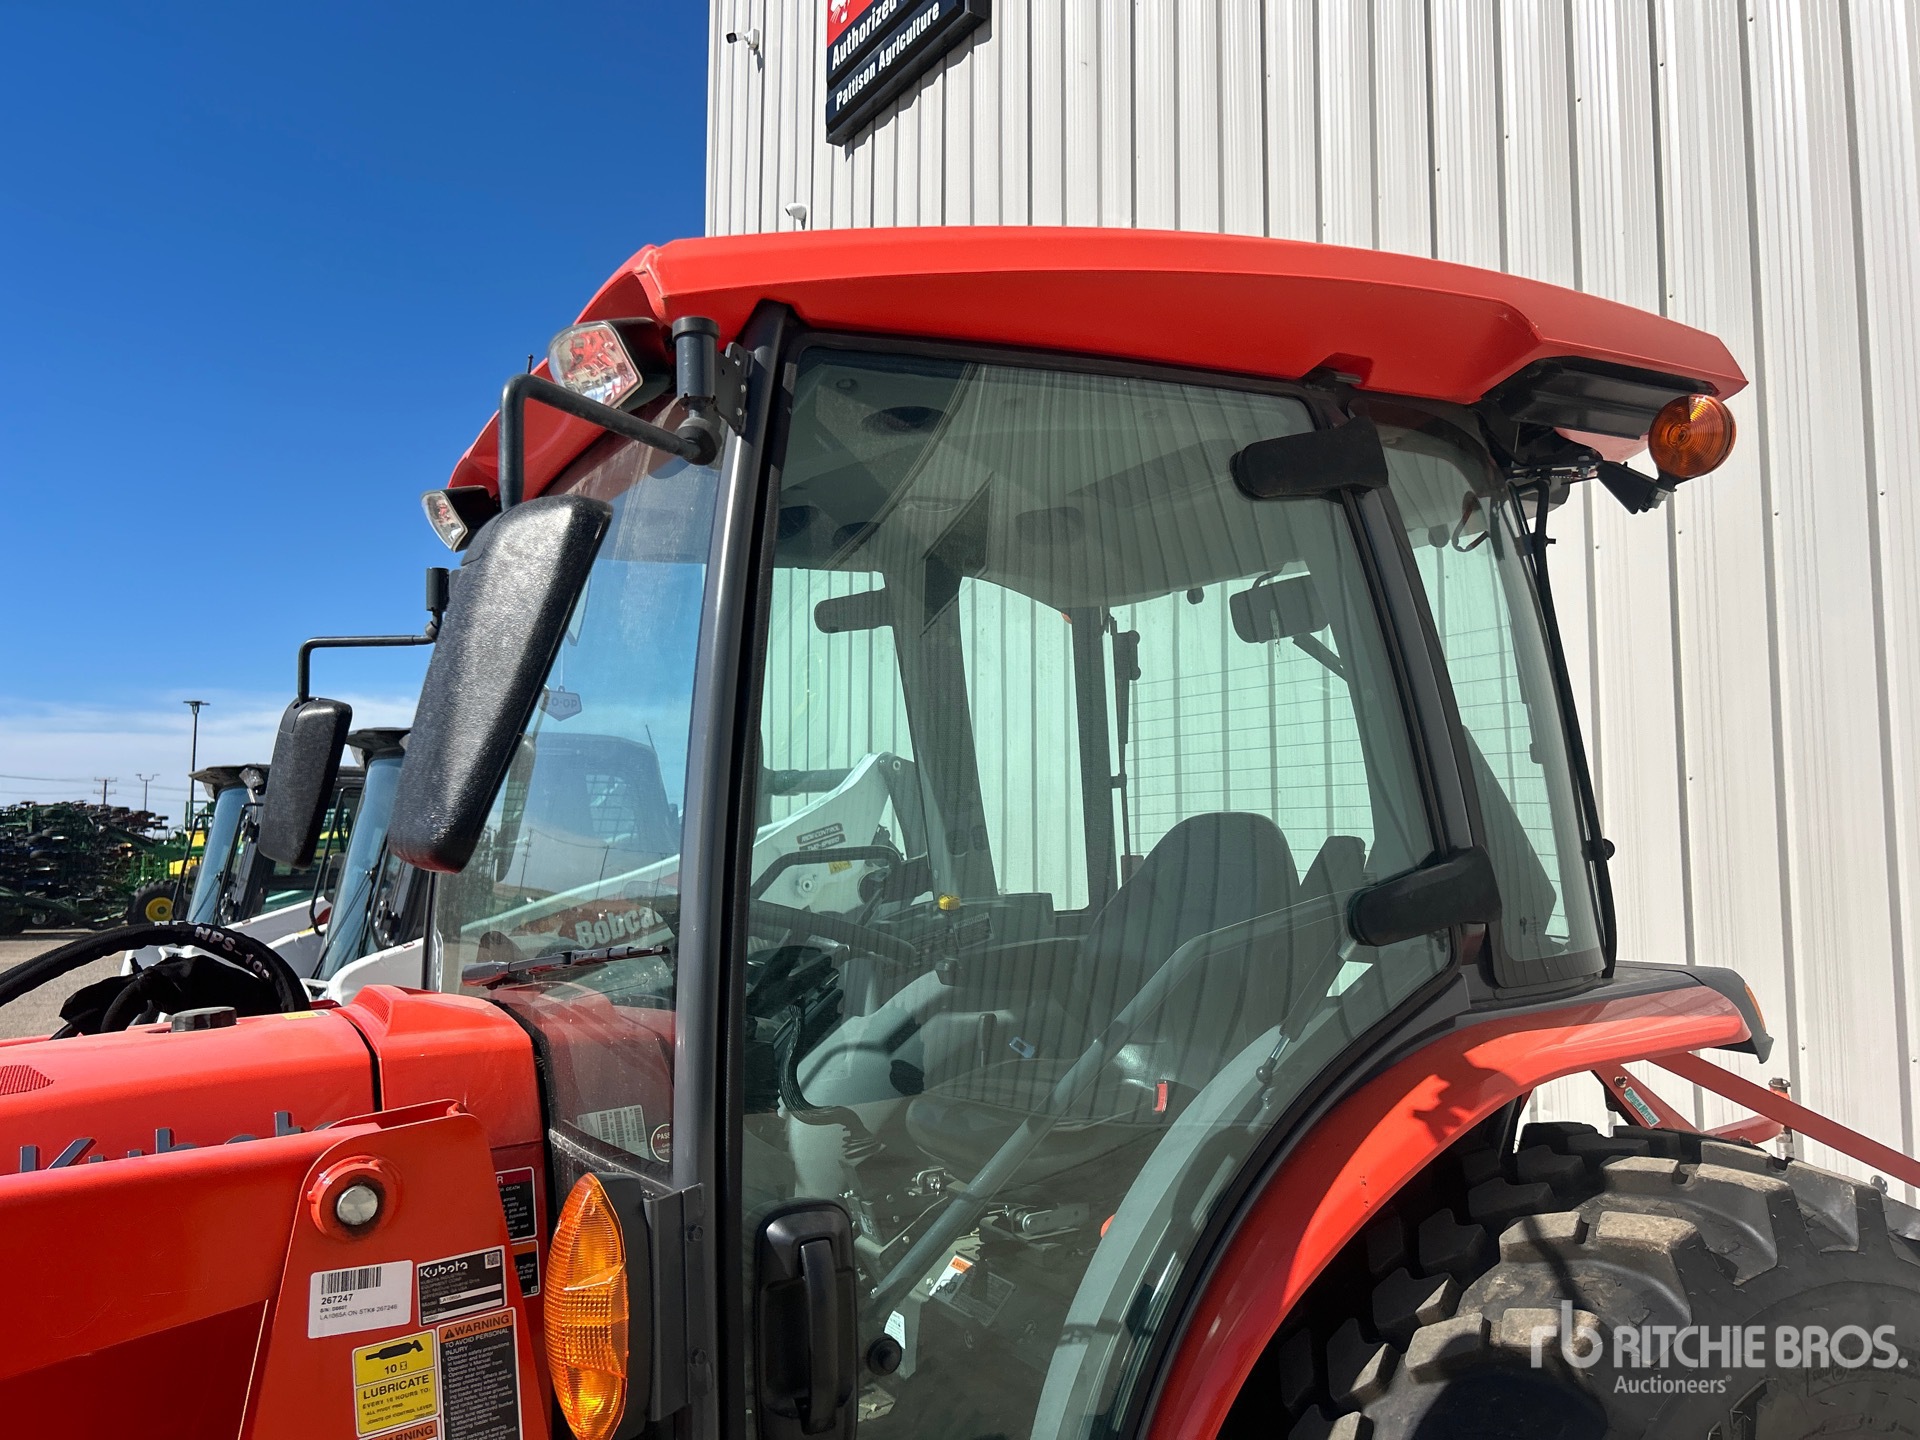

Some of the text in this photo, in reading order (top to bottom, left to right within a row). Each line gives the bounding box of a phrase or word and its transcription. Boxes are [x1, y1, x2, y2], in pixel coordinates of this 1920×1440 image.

[832, 0, 897, 70] Authorized
[836, 2, 940, 111] Pattison Agriculture
[420, 1261, 467, 1277] Kubota
[321, 1294, 353, 1305] 267247
[455, 1315, 509, 1336] WARNING
[455, 1337, 474, 1346] AVOID
[475, 1328, 509, 1341] PERSONAL
[385, 1364, 397, 1375] 10
[363, 1374, 429, 1400] LUBRICATE
[363, 1400, 383, 1409] EVERY
[396, 1391, 418, 1400] HOURS
